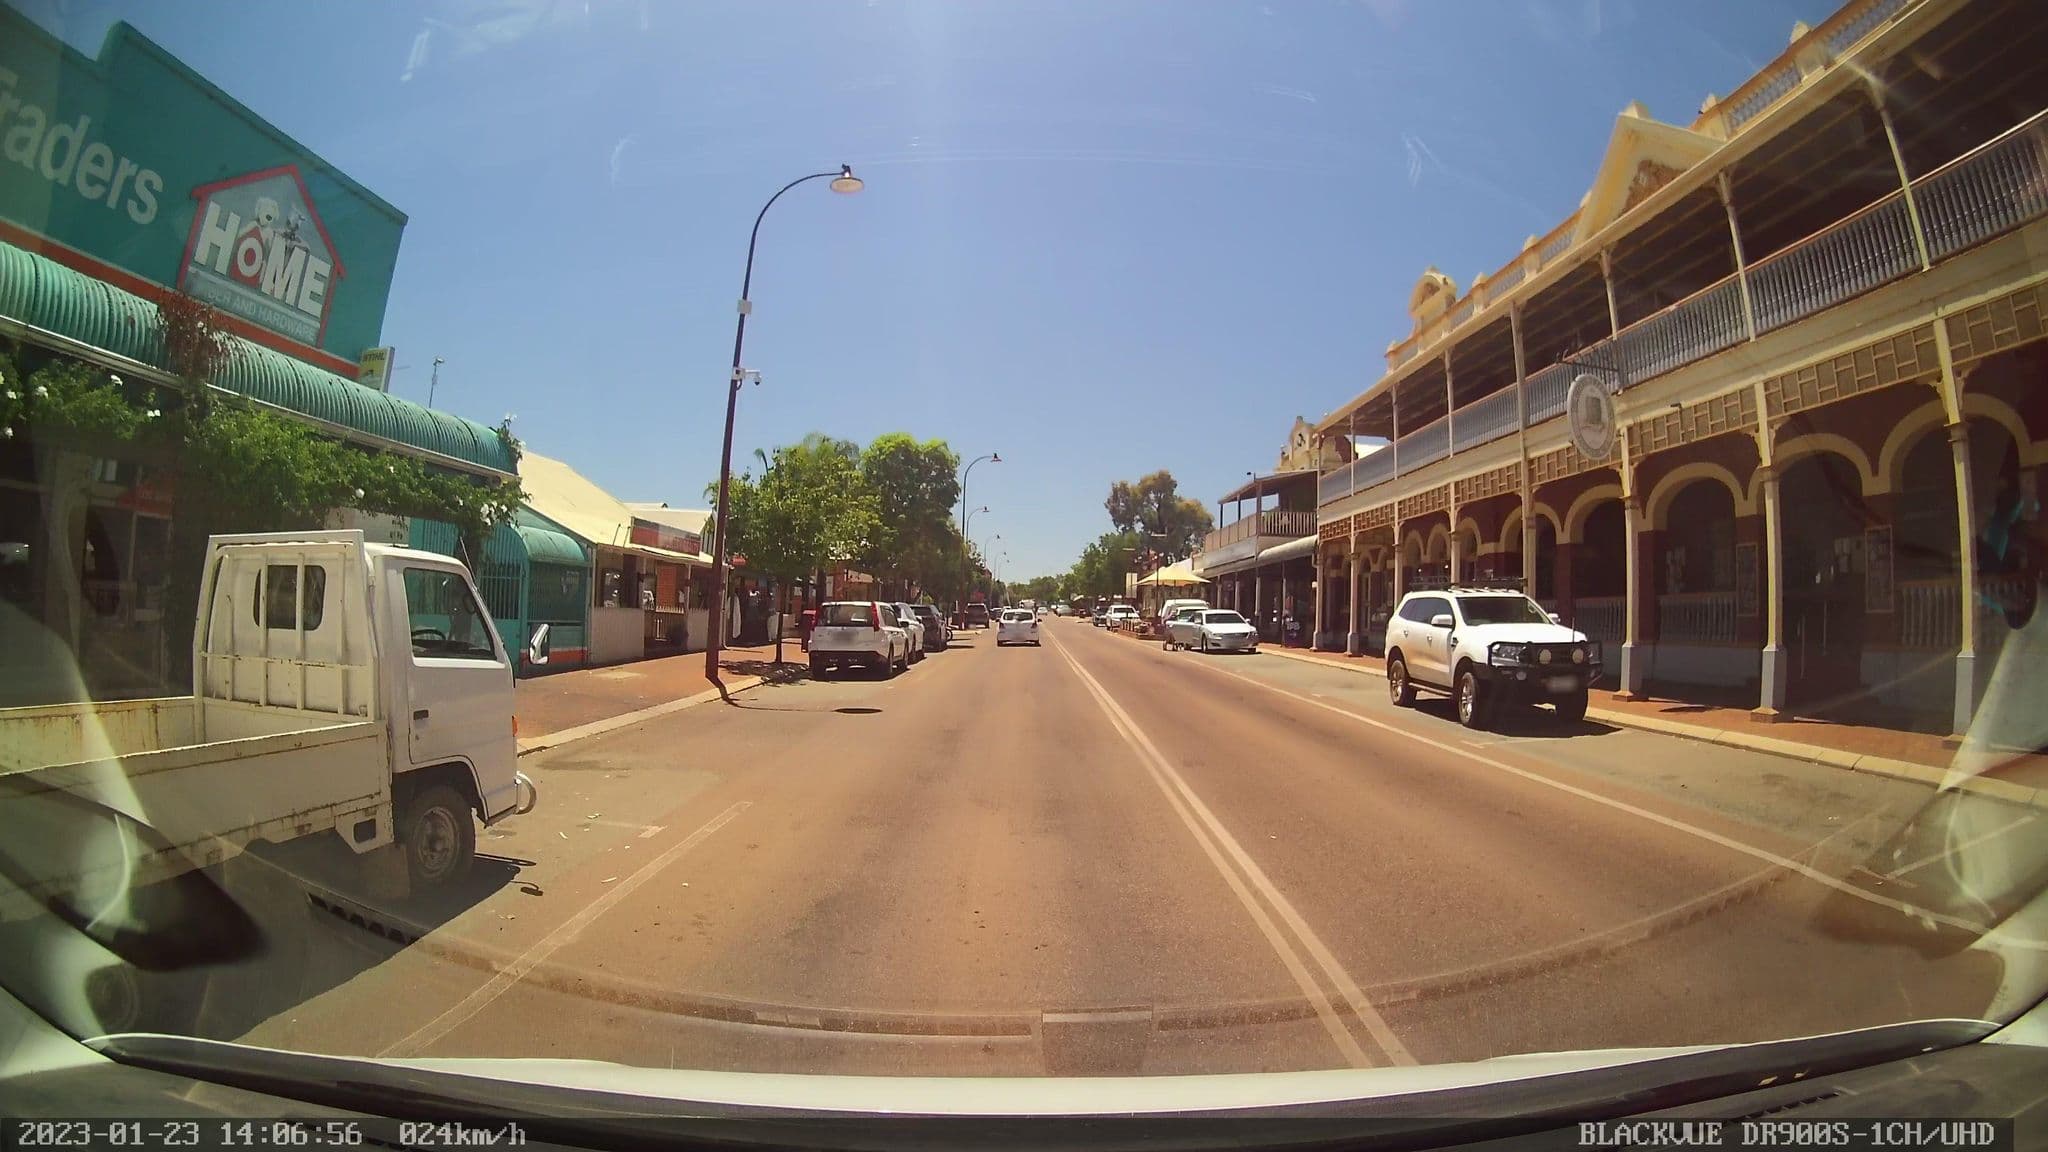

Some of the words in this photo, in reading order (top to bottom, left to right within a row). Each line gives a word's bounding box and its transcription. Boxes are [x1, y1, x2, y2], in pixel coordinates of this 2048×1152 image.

[194, 200, 332, 318] HOME
[232, 296, 256, 314] AND
[257, 306, 315, 342] HARDWARE
